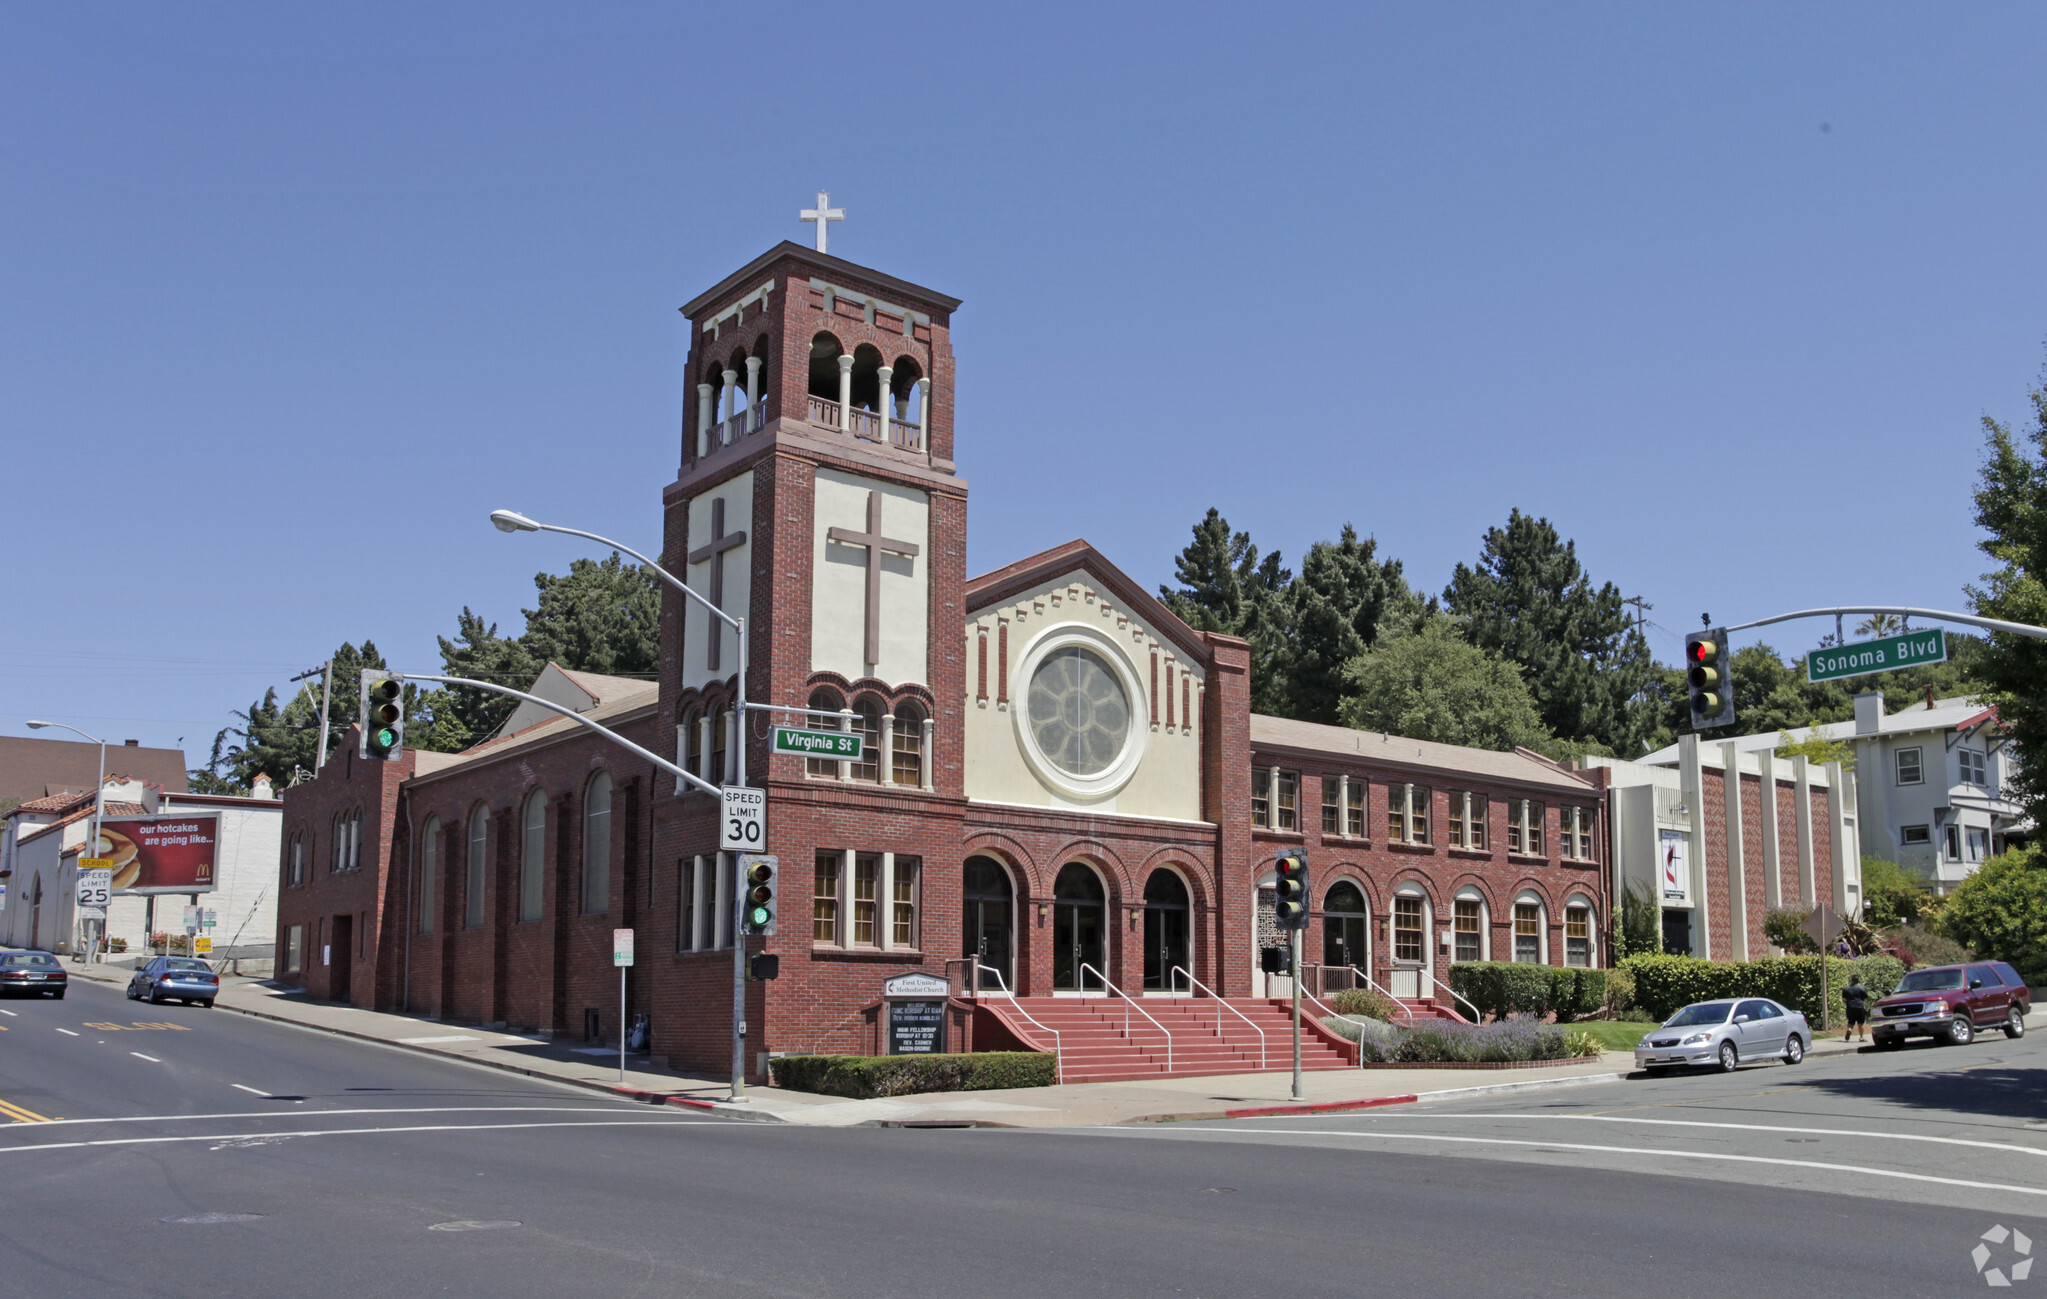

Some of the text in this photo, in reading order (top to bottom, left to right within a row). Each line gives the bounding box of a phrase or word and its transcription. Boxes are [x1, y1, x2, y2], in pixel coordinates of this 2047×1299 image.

[1816, 637, 1937, 673] Sonoma Blvd
[786, 732, 853, 751] Virginia St
[725, 792, 762, 804] SPEED
[729, 807, 758, 818] LIMIT
[140, 823, 198, 834] our hotcakes
[727, 819, 760, 843] 30
[161, 835, 188, 846] going
[189, 834, 214, 844] like...
[82, 859, 110, 867] SCHOOL
[80, 889, 108, 903] 25
[82, 1022, 193, 1031] SLOW
